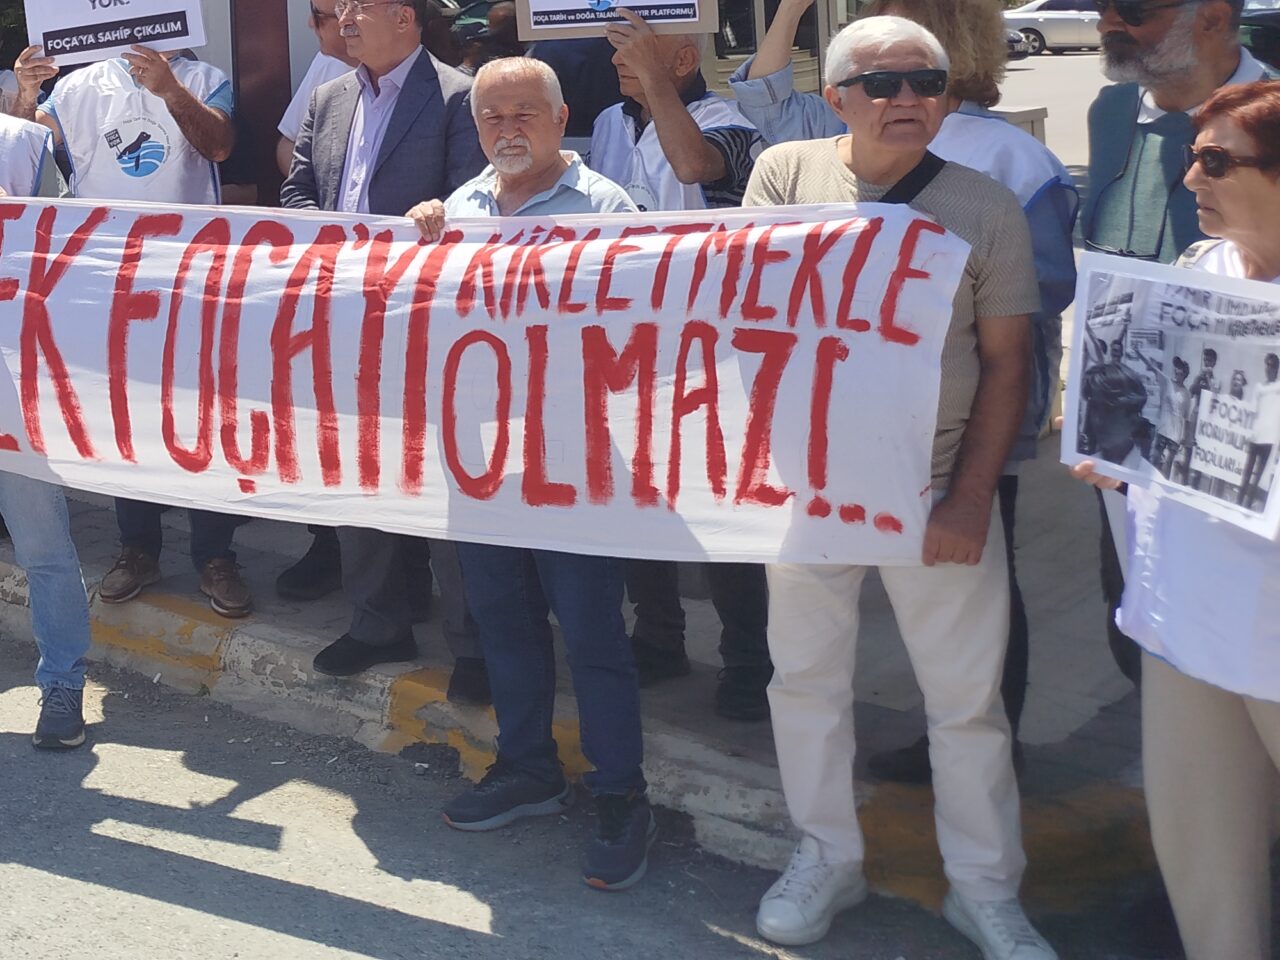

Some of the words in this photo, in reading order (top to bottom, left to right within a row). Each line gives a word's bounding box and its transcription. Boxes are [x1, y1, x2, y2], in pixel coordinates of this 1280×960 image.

[576, 11, 595, 20] DOĞA
[47, 34, 96, 51] FOÇA'YA
[98, 26, 132, 43] SAHİP
[133, 21, 182, 40] ÇIKALIM
[108, 211, 463, 497] FOÇA'YI
[455, 216, 947, 347] KİRLETMEKLE
